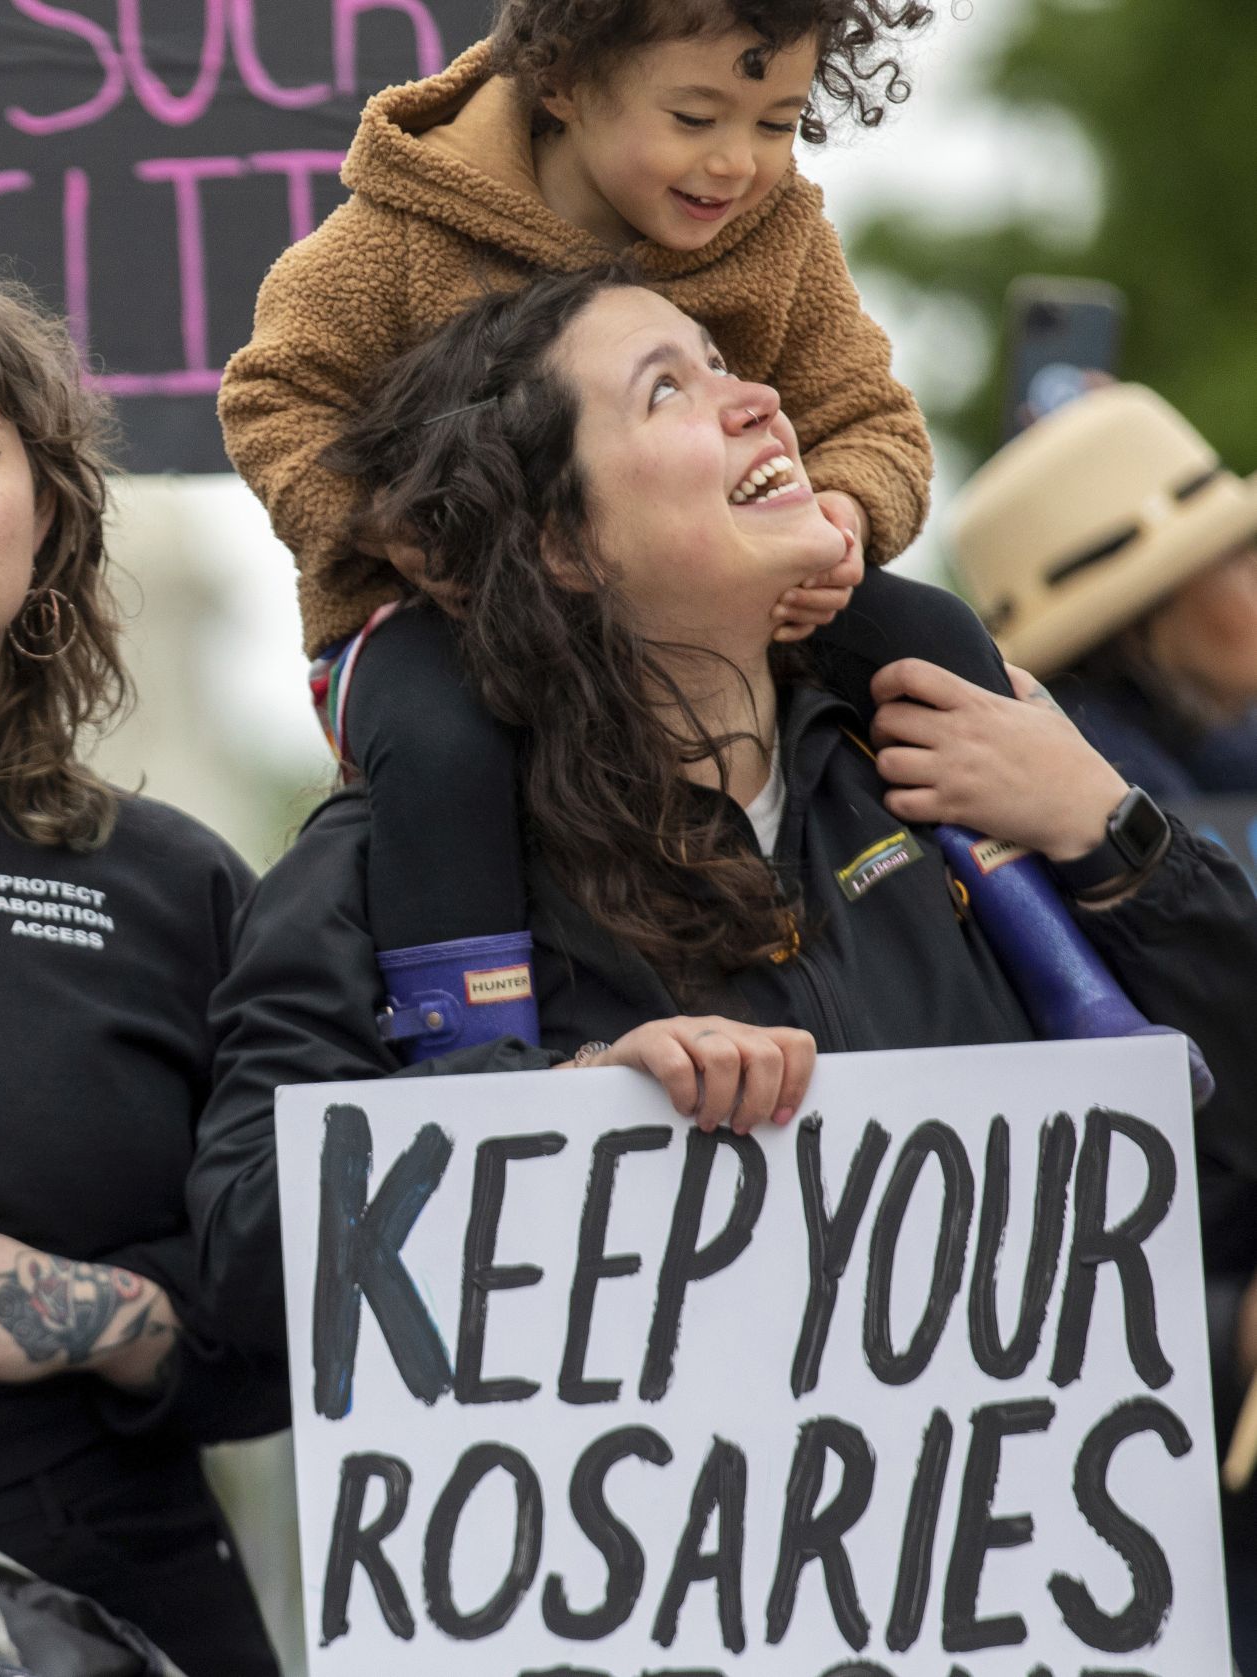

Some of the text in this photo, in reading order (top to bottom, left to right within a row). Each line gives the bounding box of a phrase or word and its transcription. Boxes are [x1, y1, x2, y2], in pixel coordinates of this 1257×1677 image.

[10, 919, 105, 950] ACCESS
[472, 976, 528, 992] HUNTER
[311, 1102, 1177, 1420] KEEP YOUR
[319, 1396, 1192, 1654] ROSARIES
